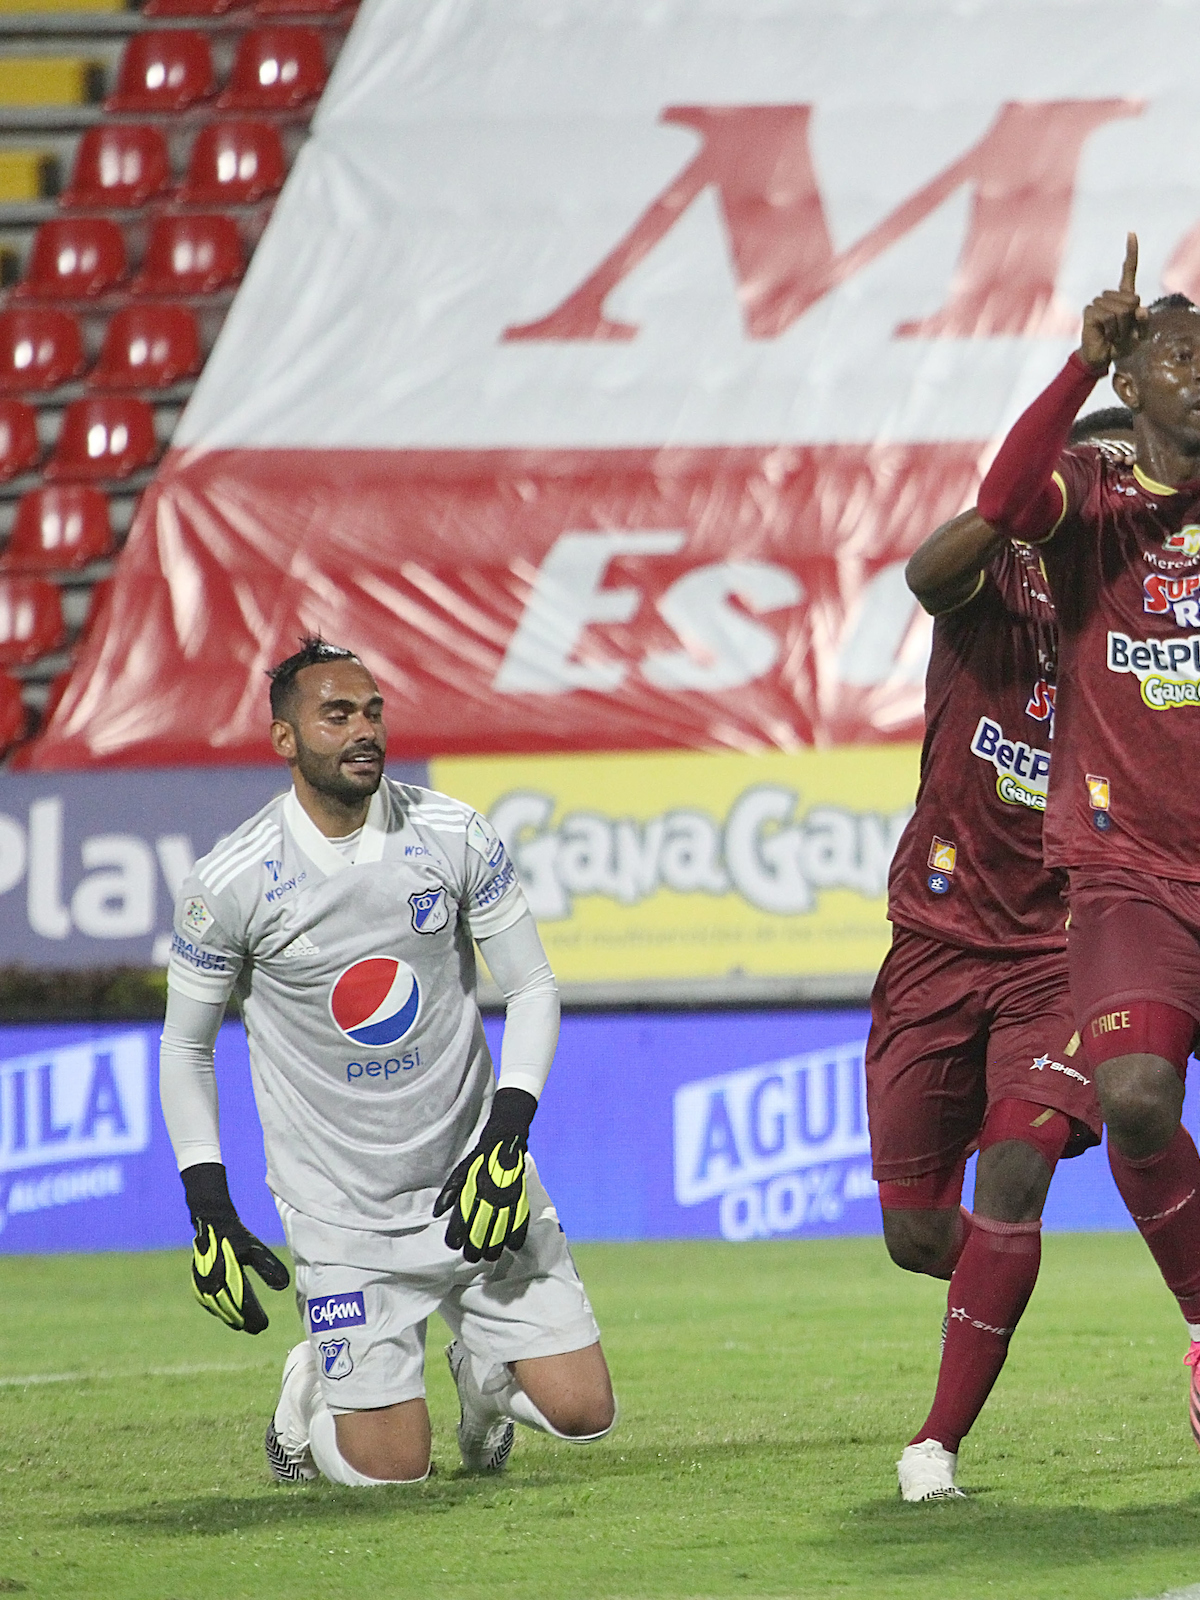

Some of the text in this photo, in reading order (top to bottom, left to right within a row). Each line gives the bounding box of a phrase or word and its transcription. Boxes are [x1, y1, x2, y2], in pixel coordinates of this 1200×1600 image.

[492, 530, 801, 695] Es
[11, 1053, 129, 1151] ILA
[346, 1047, 420, 1082] pepsi
